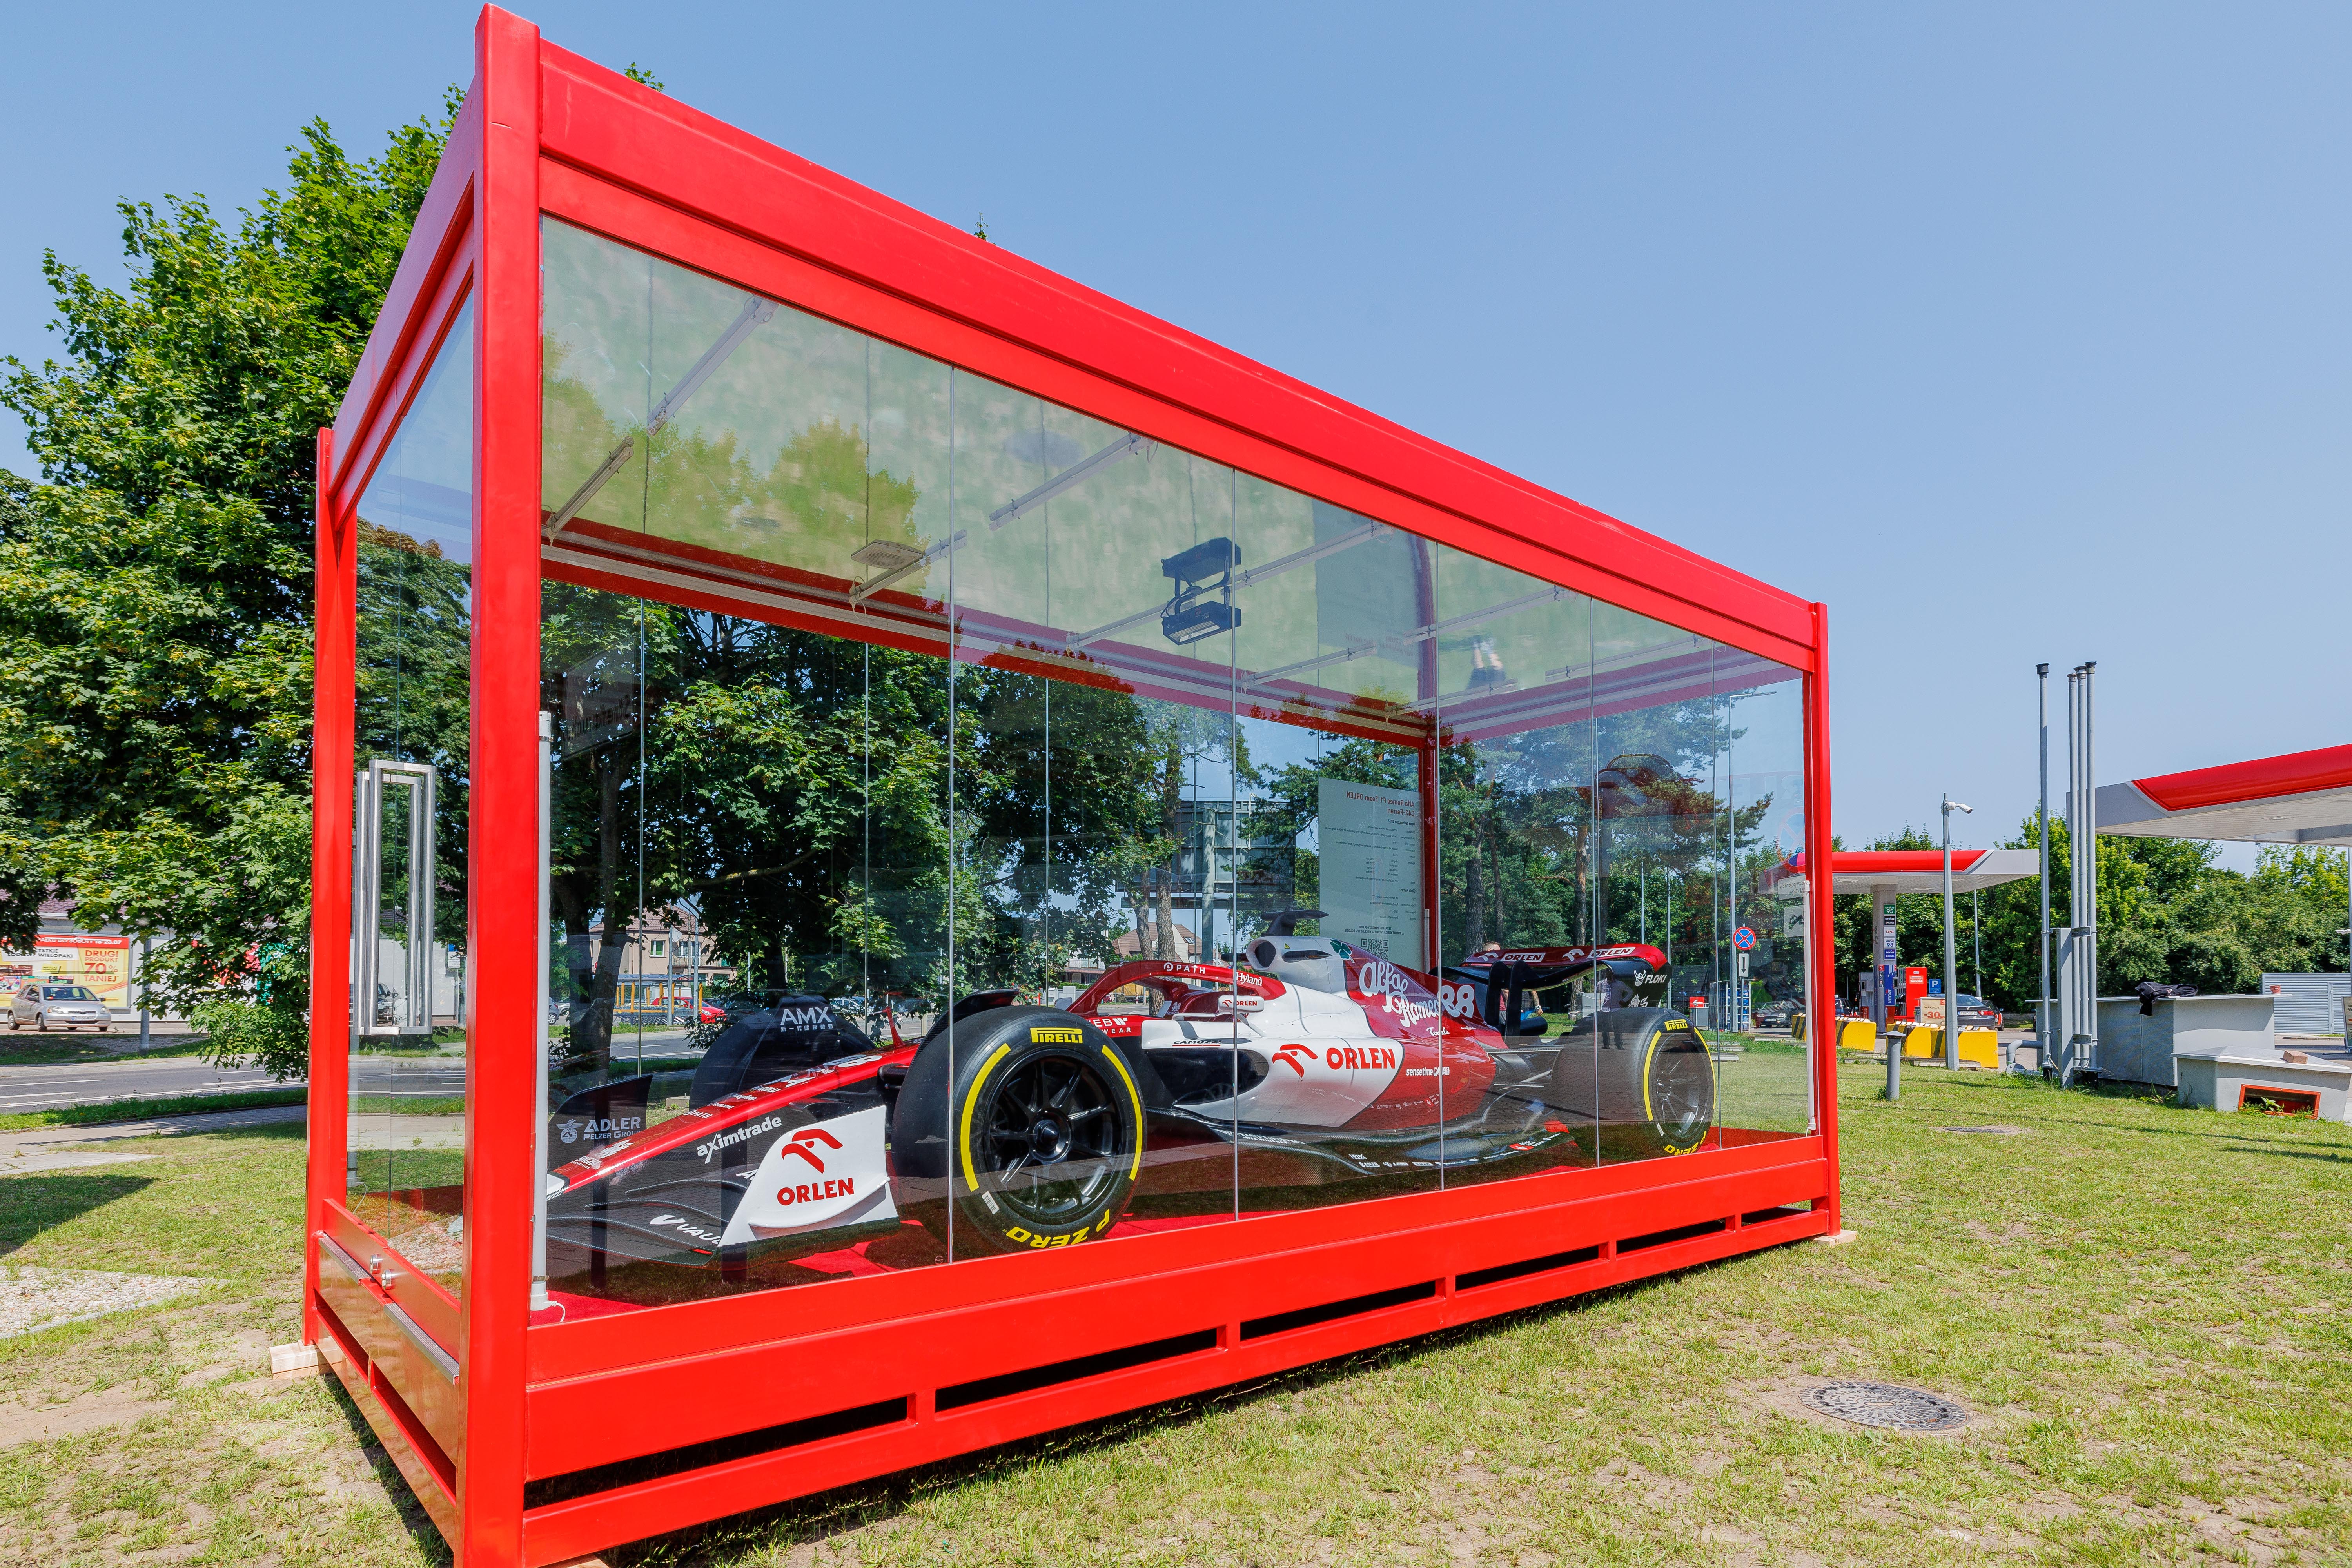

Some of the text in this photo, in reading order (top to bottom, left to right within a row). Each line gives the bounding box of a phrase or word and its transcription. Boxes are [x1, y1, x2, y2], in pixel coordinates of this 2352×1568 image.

[1591, 948, 1630, 956] ORLEN
[84, 962, 108, 975] 70
[1176, 964, 1205, 975] PATH
[1236, 971, 1262, 986] Hyland
[1644, 974, 1668, 984] FLOKI
[1437, 985, 1475, 1018] 88
[780, 1006, 833, 1026] AMX
[1664, 1019, 1688, 1031] PIRELLI
[1030, 1027, 1083, 1044] PIRELLI
[822, 1054, 883, 1067] 88
[1326, 1047, 1396, 1070] ORLEN
[1406, 1067, 1433, 1076] sensetime
[583, 1117, 641, 1133] ADLER
[697, 1116, 782, 1164] aximtrade
[777, 1177, 855, 1206] ORLEN
[1096, 1209, 1110, 1232] P
[1006, 1227, 1090, 1249] ZERO
